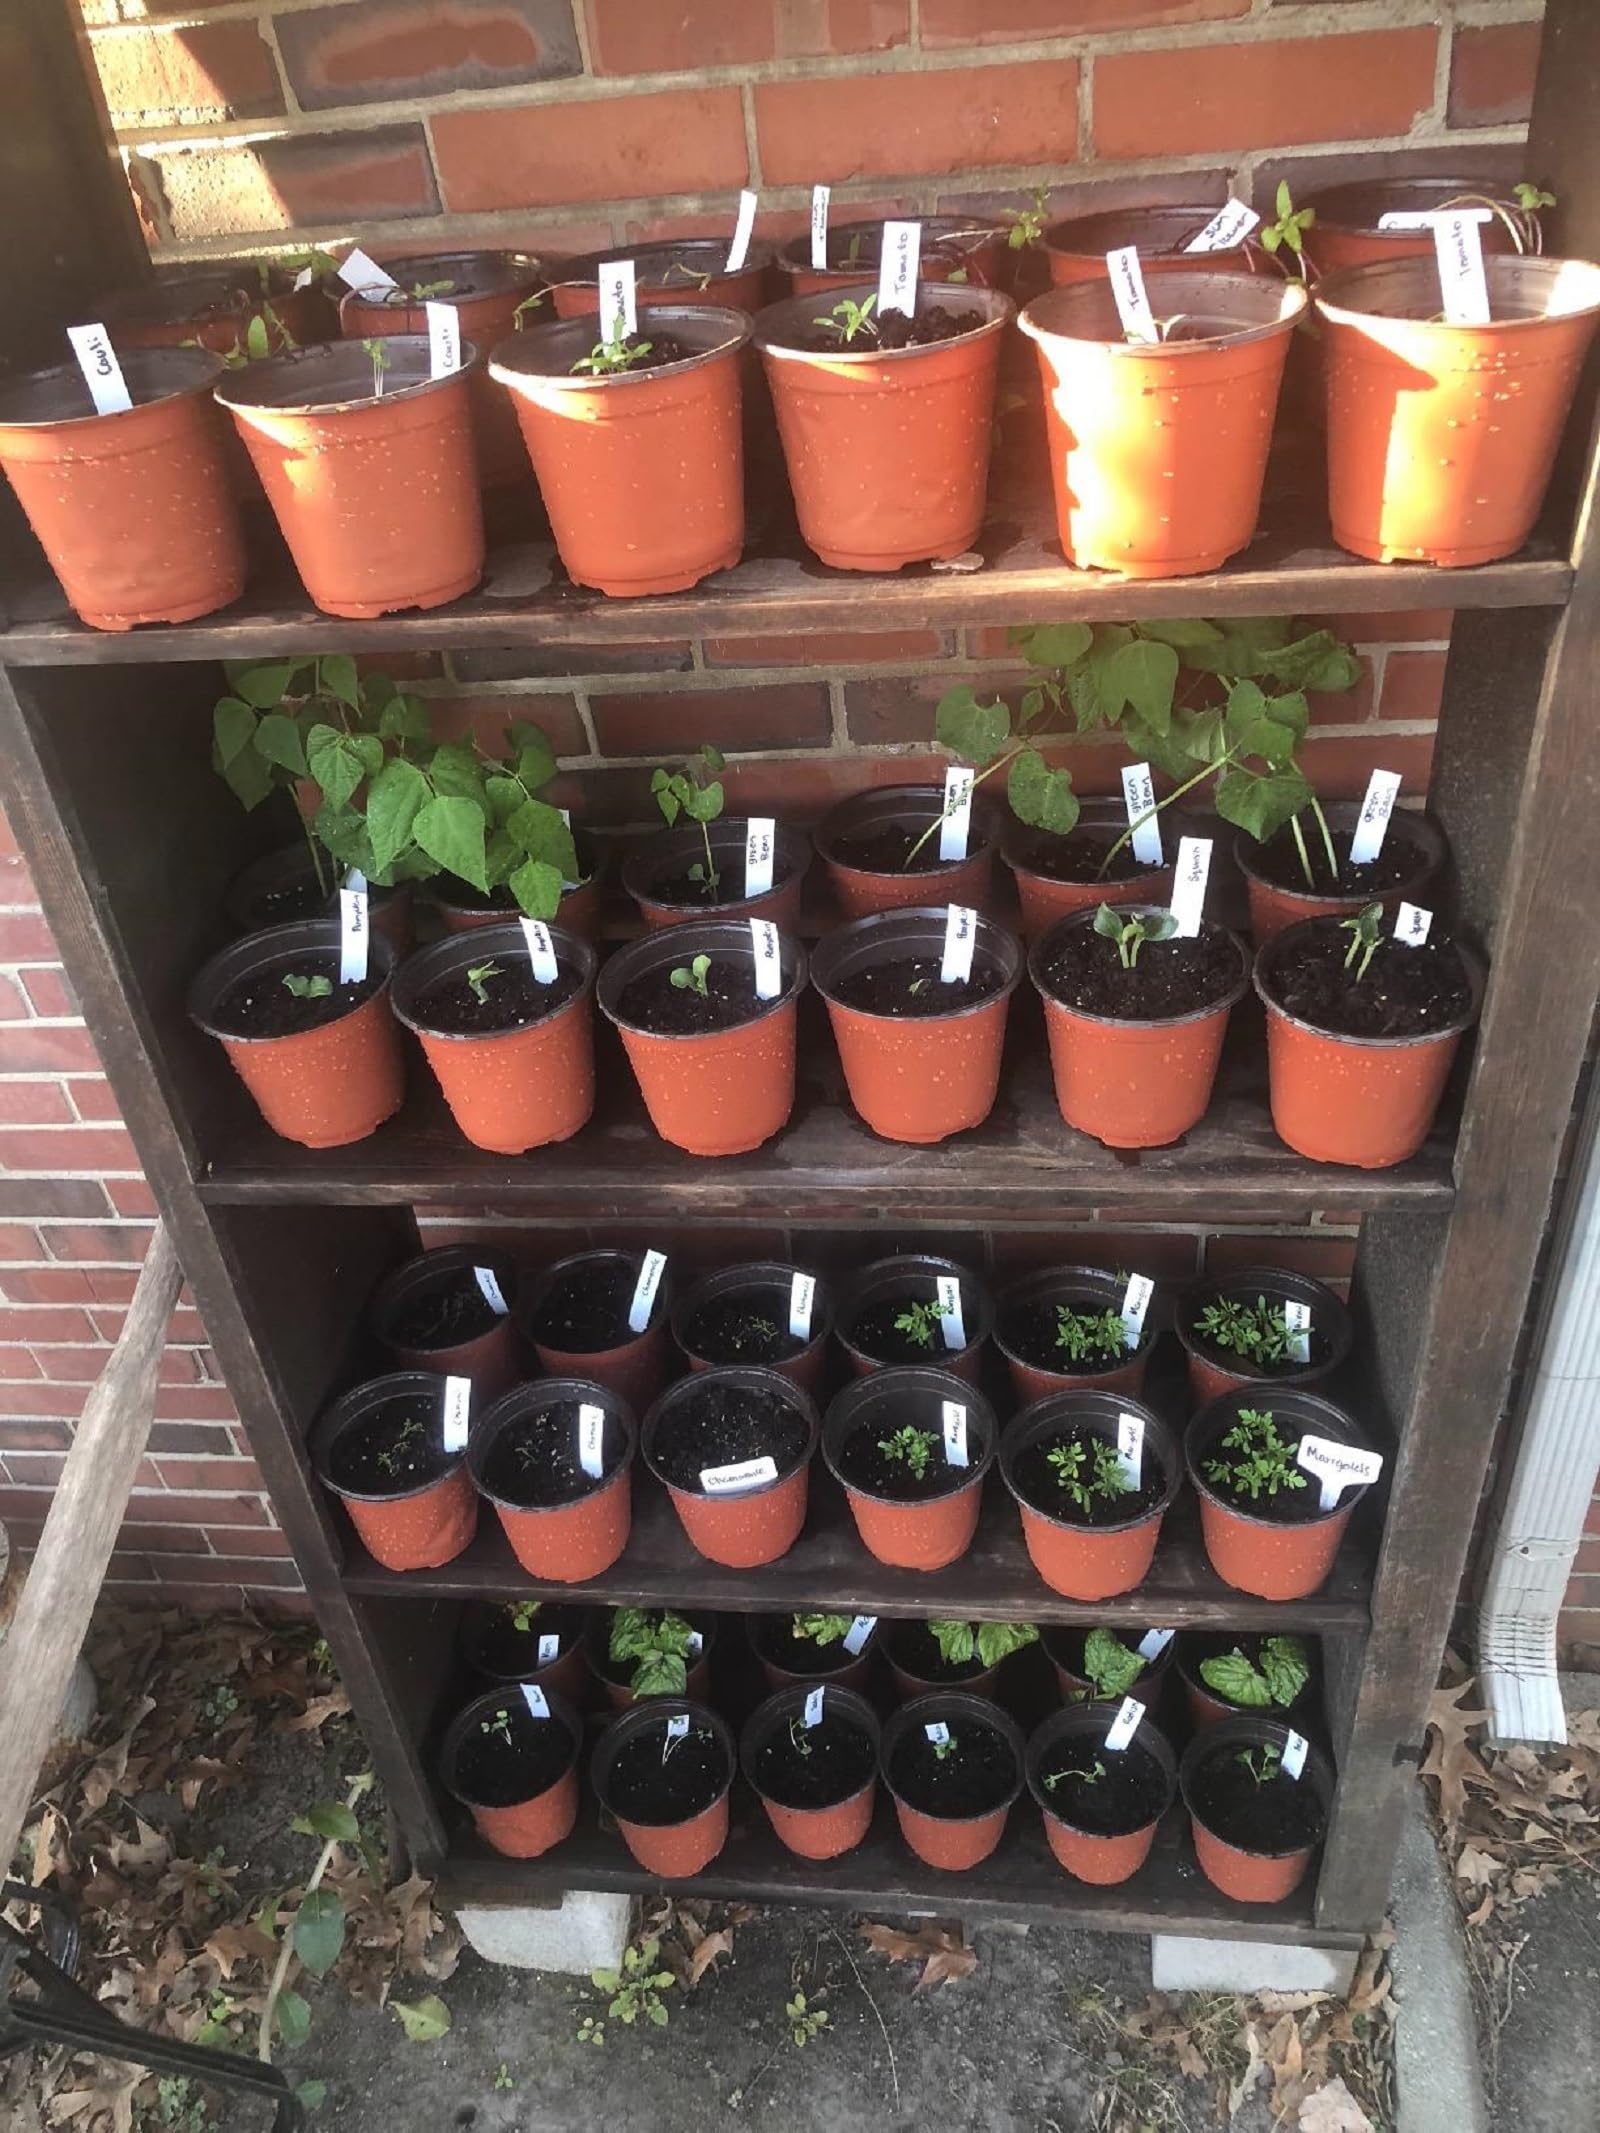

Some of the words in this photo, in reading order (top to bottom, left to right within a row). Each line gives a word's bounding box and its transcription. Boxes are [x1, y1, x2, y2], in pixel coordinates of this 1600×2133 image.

[893, 232, 908, 295] Tomato
[1120, 254, 1140, 311] Tomato
[87, 336, 113, 377] Cauli
